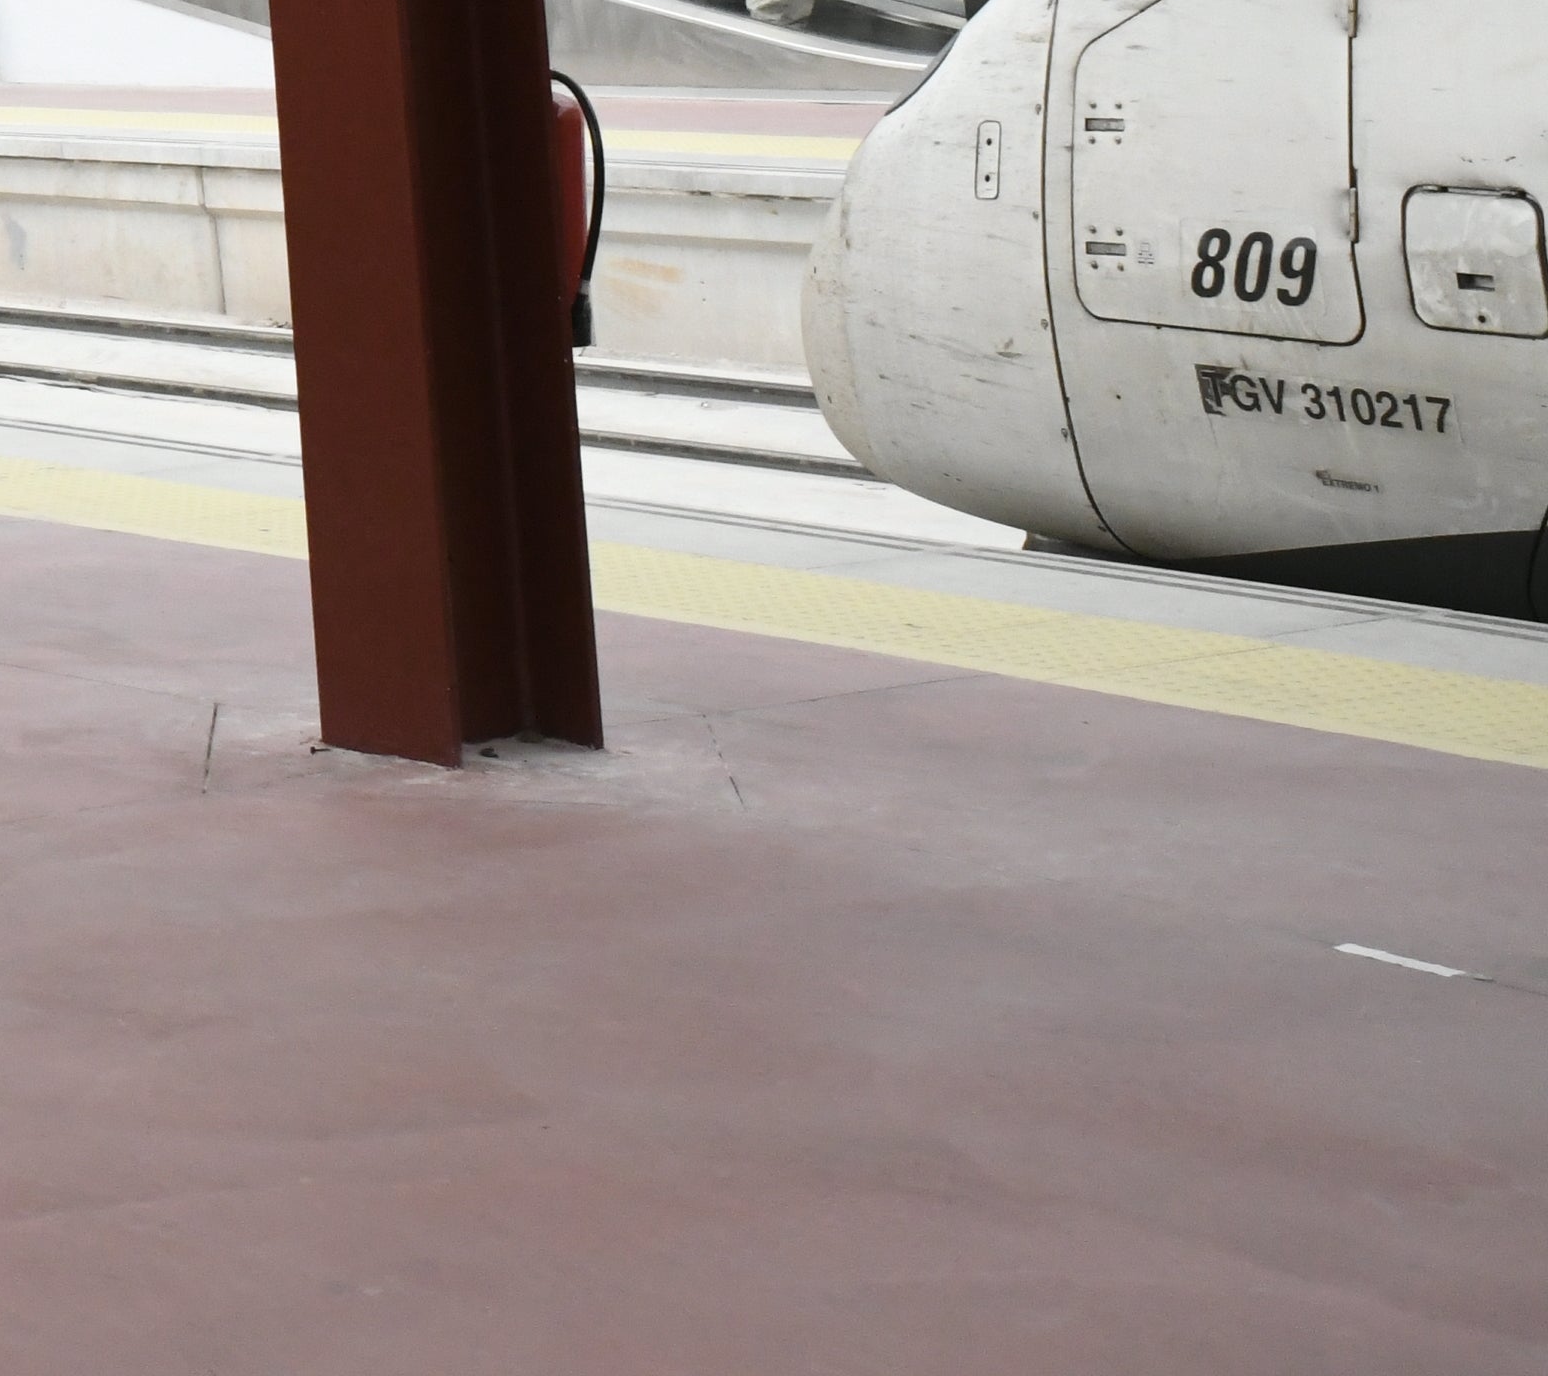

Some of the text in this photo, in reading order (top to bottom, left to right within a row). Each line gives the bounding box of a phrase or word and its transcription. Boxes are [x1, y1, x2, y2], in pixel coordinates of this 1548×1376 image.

[1190, 227, 1318, 307] 809
[1201, 368, 1451, 434] TGV 310217
